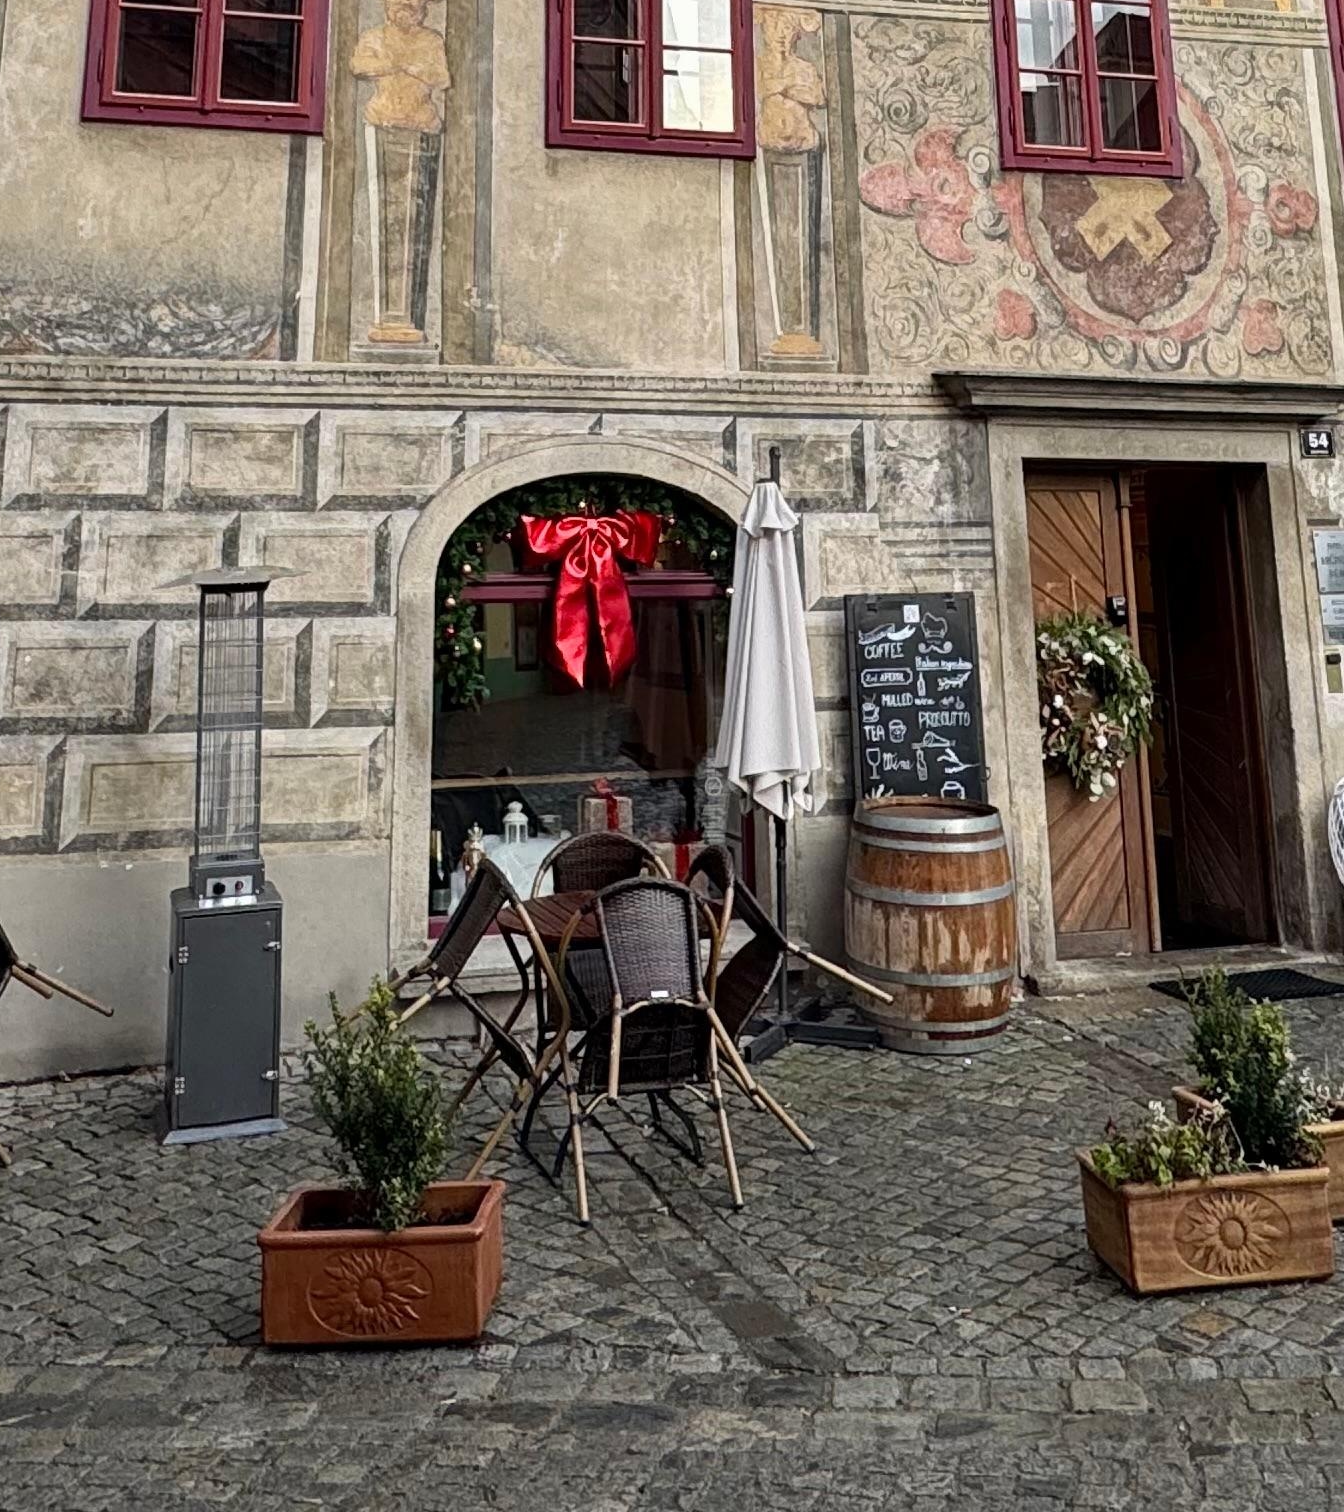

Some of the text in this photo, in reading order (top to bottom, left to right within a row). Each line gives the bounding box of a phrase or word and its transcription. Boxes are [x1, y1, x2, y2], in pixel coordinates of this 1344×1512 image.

[1308, 432, 1329, 448] 54
[864, 642, 904, 660] COFFEE
[881, 693, 914, 707] MULLED
[863, 724, 885, 742] TEA
[882, 752, 915, 771] Wine
